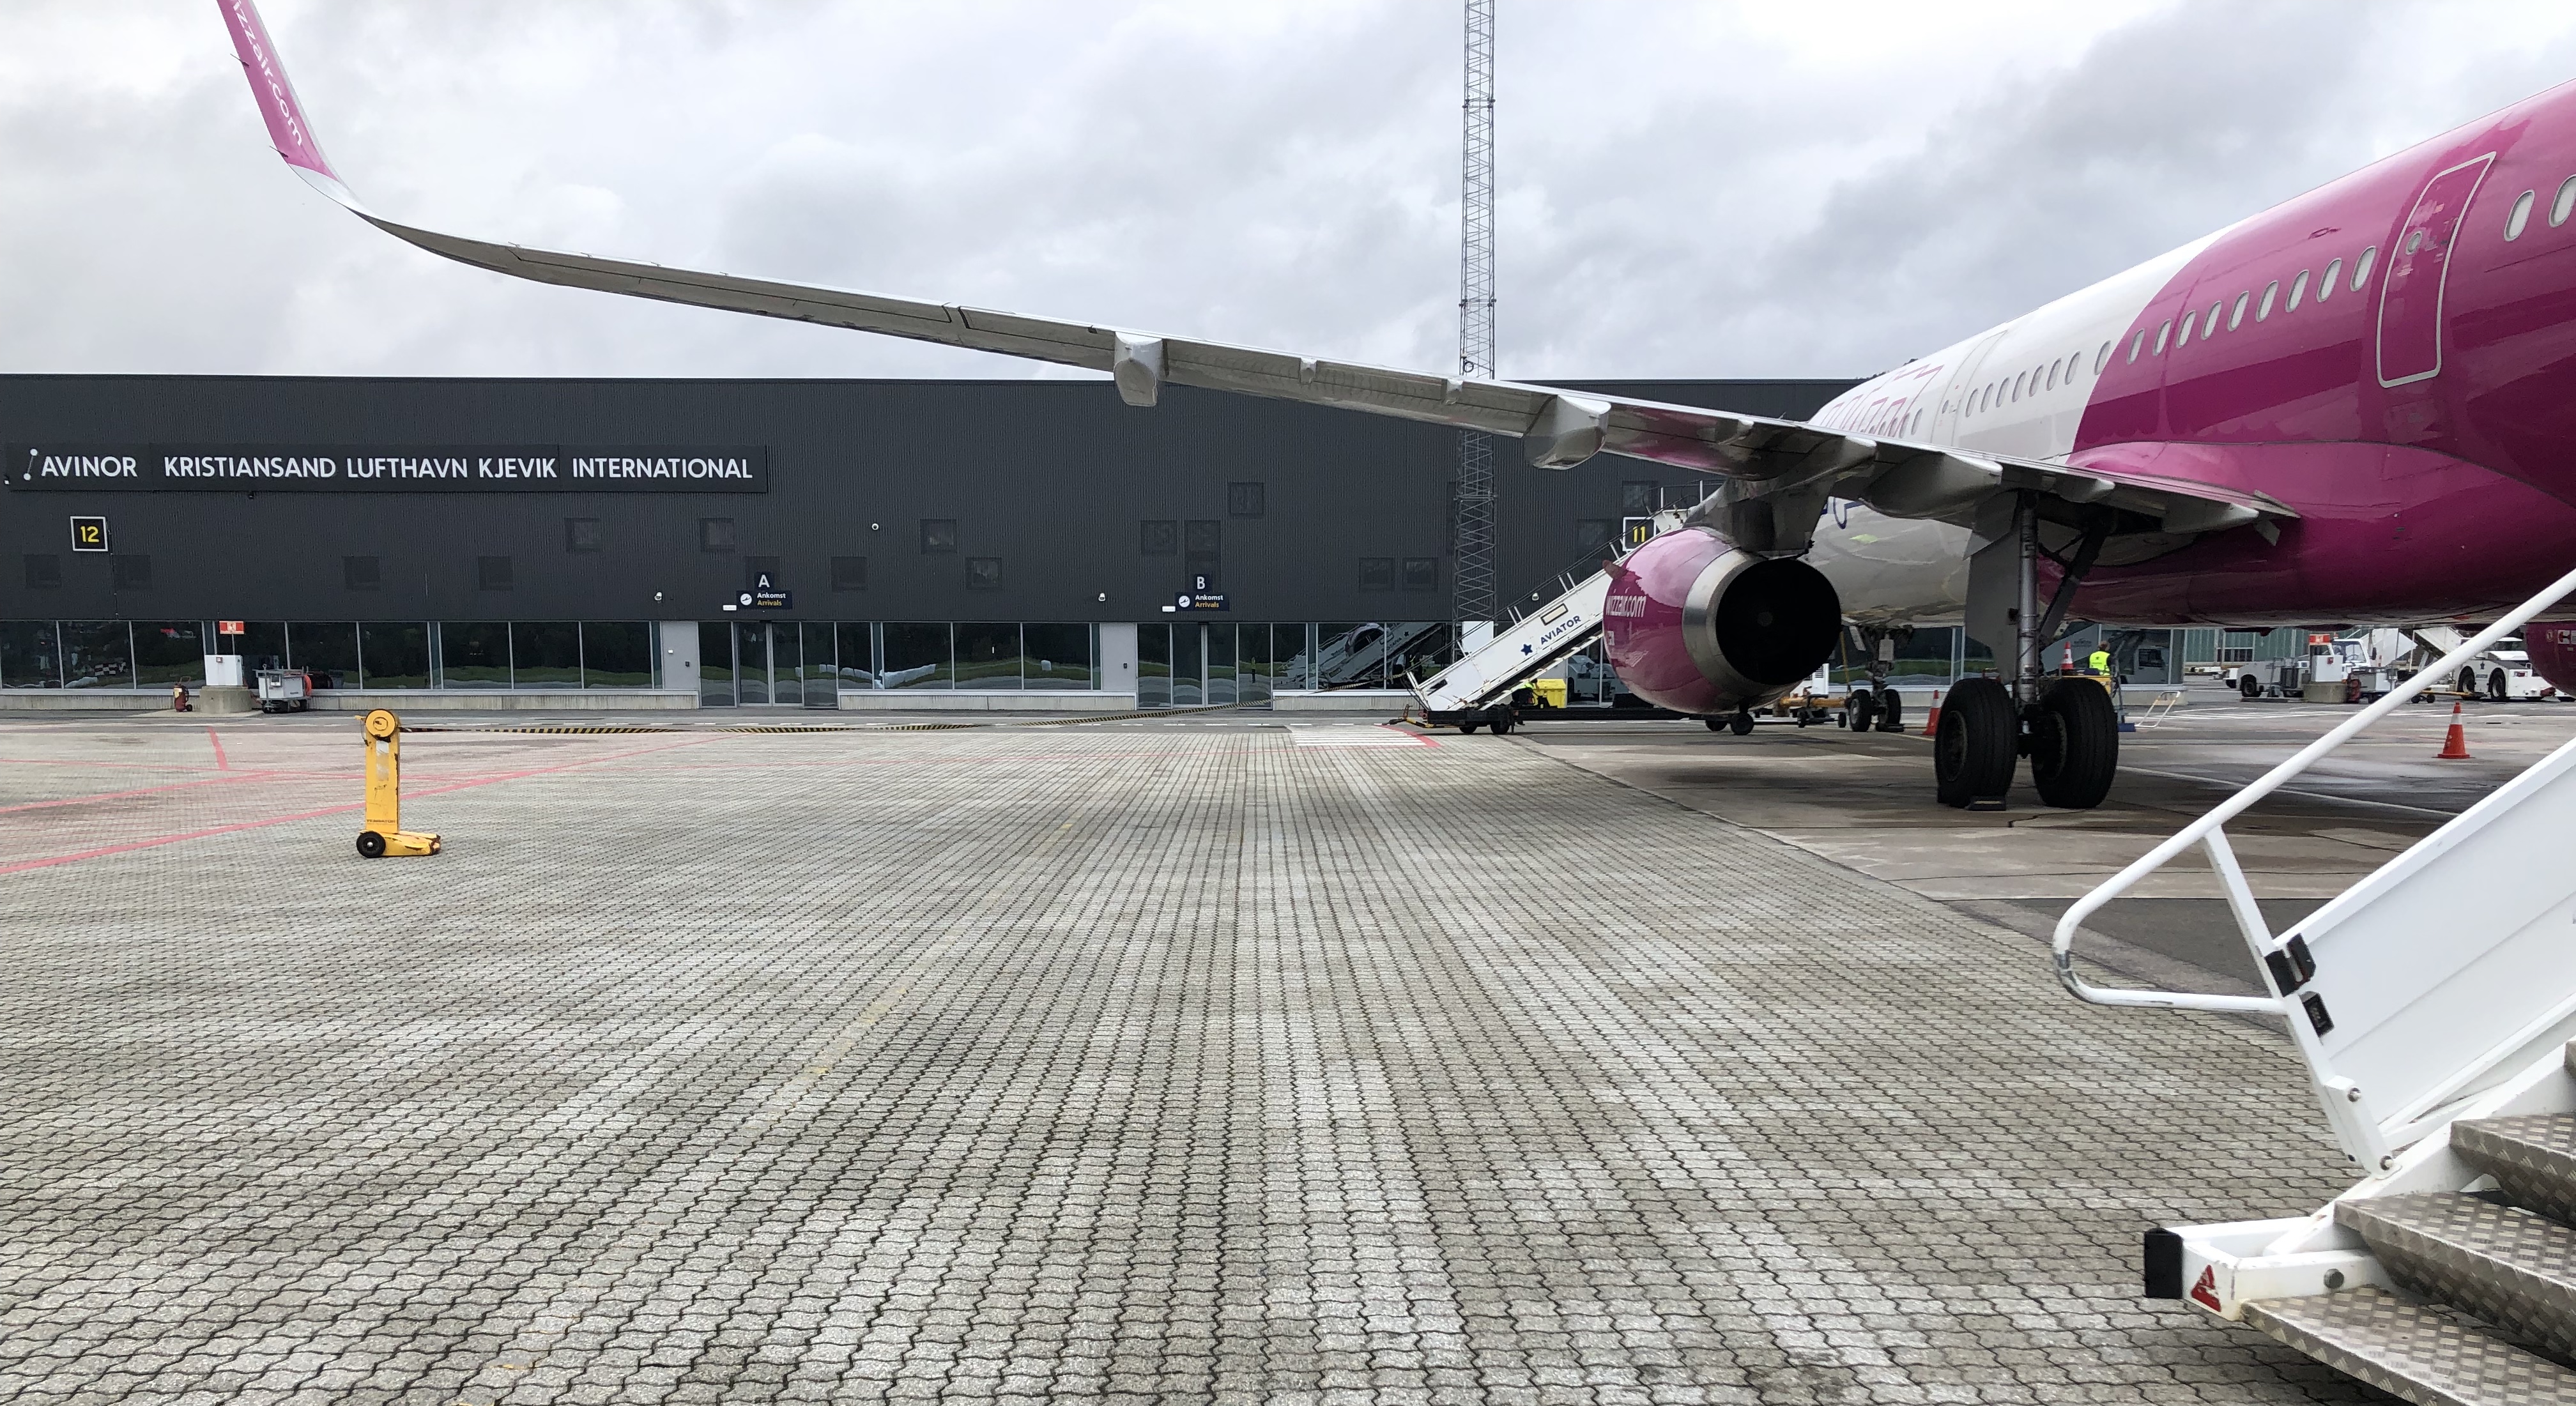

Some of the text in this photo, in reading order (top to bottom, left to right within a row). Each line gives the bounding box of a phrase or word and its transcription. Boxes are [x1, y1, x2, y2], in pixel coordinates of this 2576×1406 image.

[232, 0, 302, 146] izzair.com
[42, 455, 753, 478] AVINOR KRISTIANSAND LUFTHAVN KJEVIK INTERNATIONAL
[80, 526, 100, 543] 12
[1633, 526, 1646, 542] 11
[758, 574, 770, 588] A
[1197, 576, 1206, 590] B
[1540, 615, 1582, 645] AVIATOR
